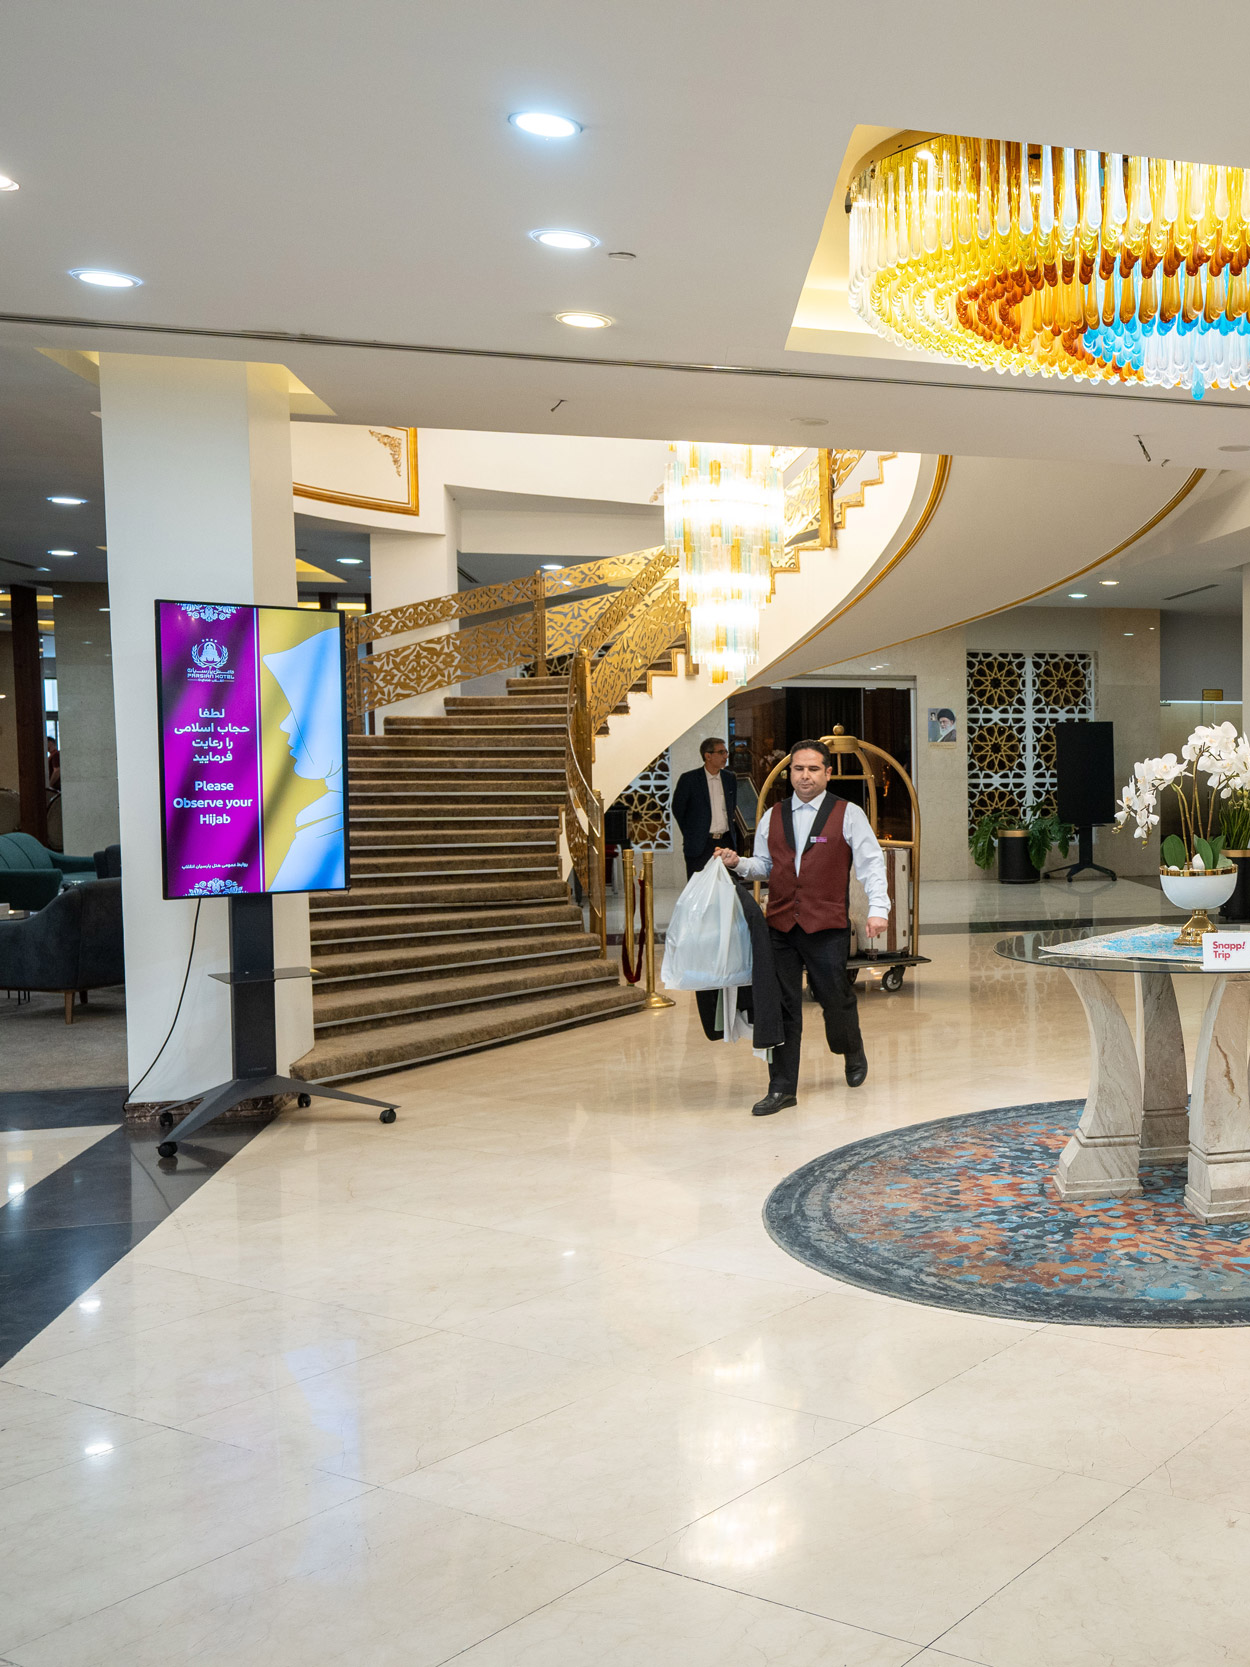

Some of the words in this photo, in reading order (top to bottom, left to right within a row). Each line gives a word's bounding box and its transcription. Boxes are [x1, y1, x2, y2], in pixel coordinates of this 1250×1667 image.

[198, 708, 225, 718] لطفا
[174, 722, 214, 735] اسلامی
[217, 722, 250, 735] حجاب
[191, 737, 224, 749] رعایت
[225, 737, 234, 749] را
[192, 750, 233, 764] فرمایید
[194, 780, 234, 791] Please
[173, 797, 223, 808] Observe
[225, 799, 253, 809] your
[199, 813, 231, 826] Hijab
[1212, 941, 1246, 951] Snapp!
[1213, 950, 1231, 961] Trip
